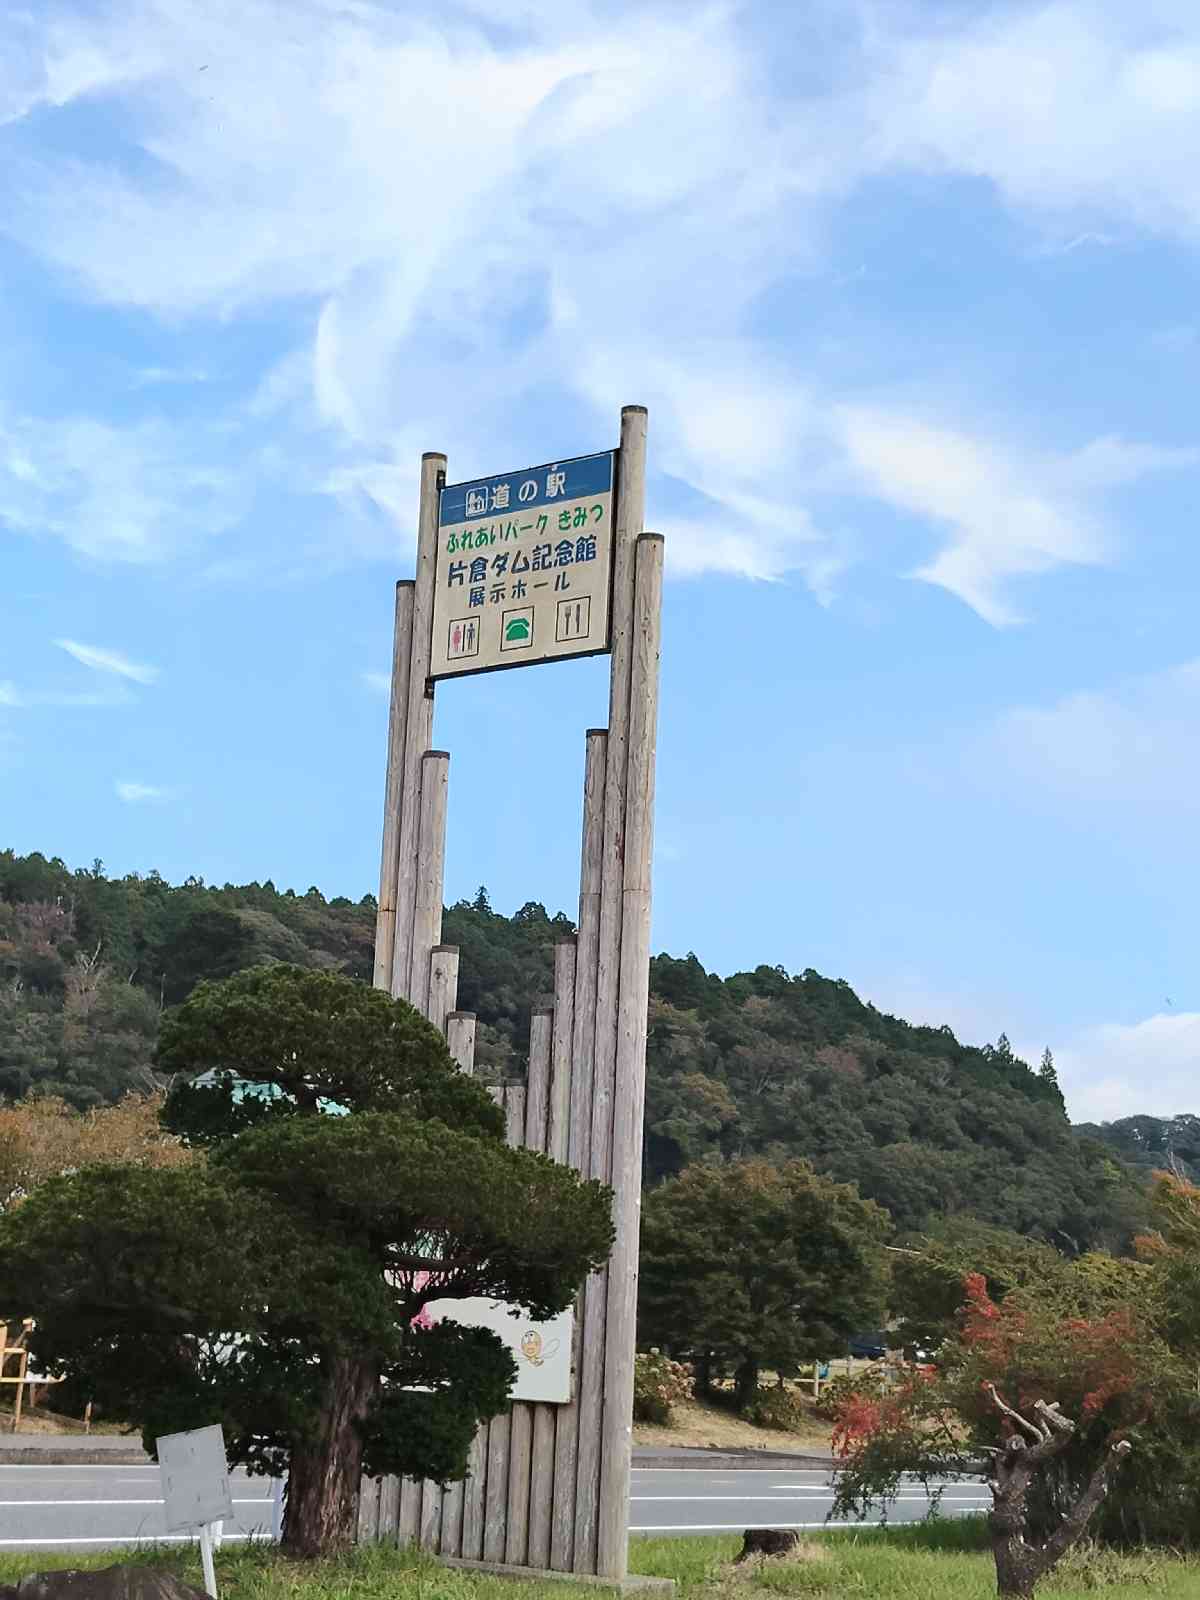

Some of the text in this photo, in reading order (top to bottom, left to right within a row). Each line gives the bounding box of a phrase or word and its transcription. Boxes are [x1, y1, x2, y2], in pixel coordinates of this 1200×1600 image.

[490, 472, 566, 510] 道の駅
[446, 504, 604, 553] ふれあいパーク きみつ
[448, 534, 597, 588] 片倉ダム記念館
[468, 572, 571, 608] 展示ホール
